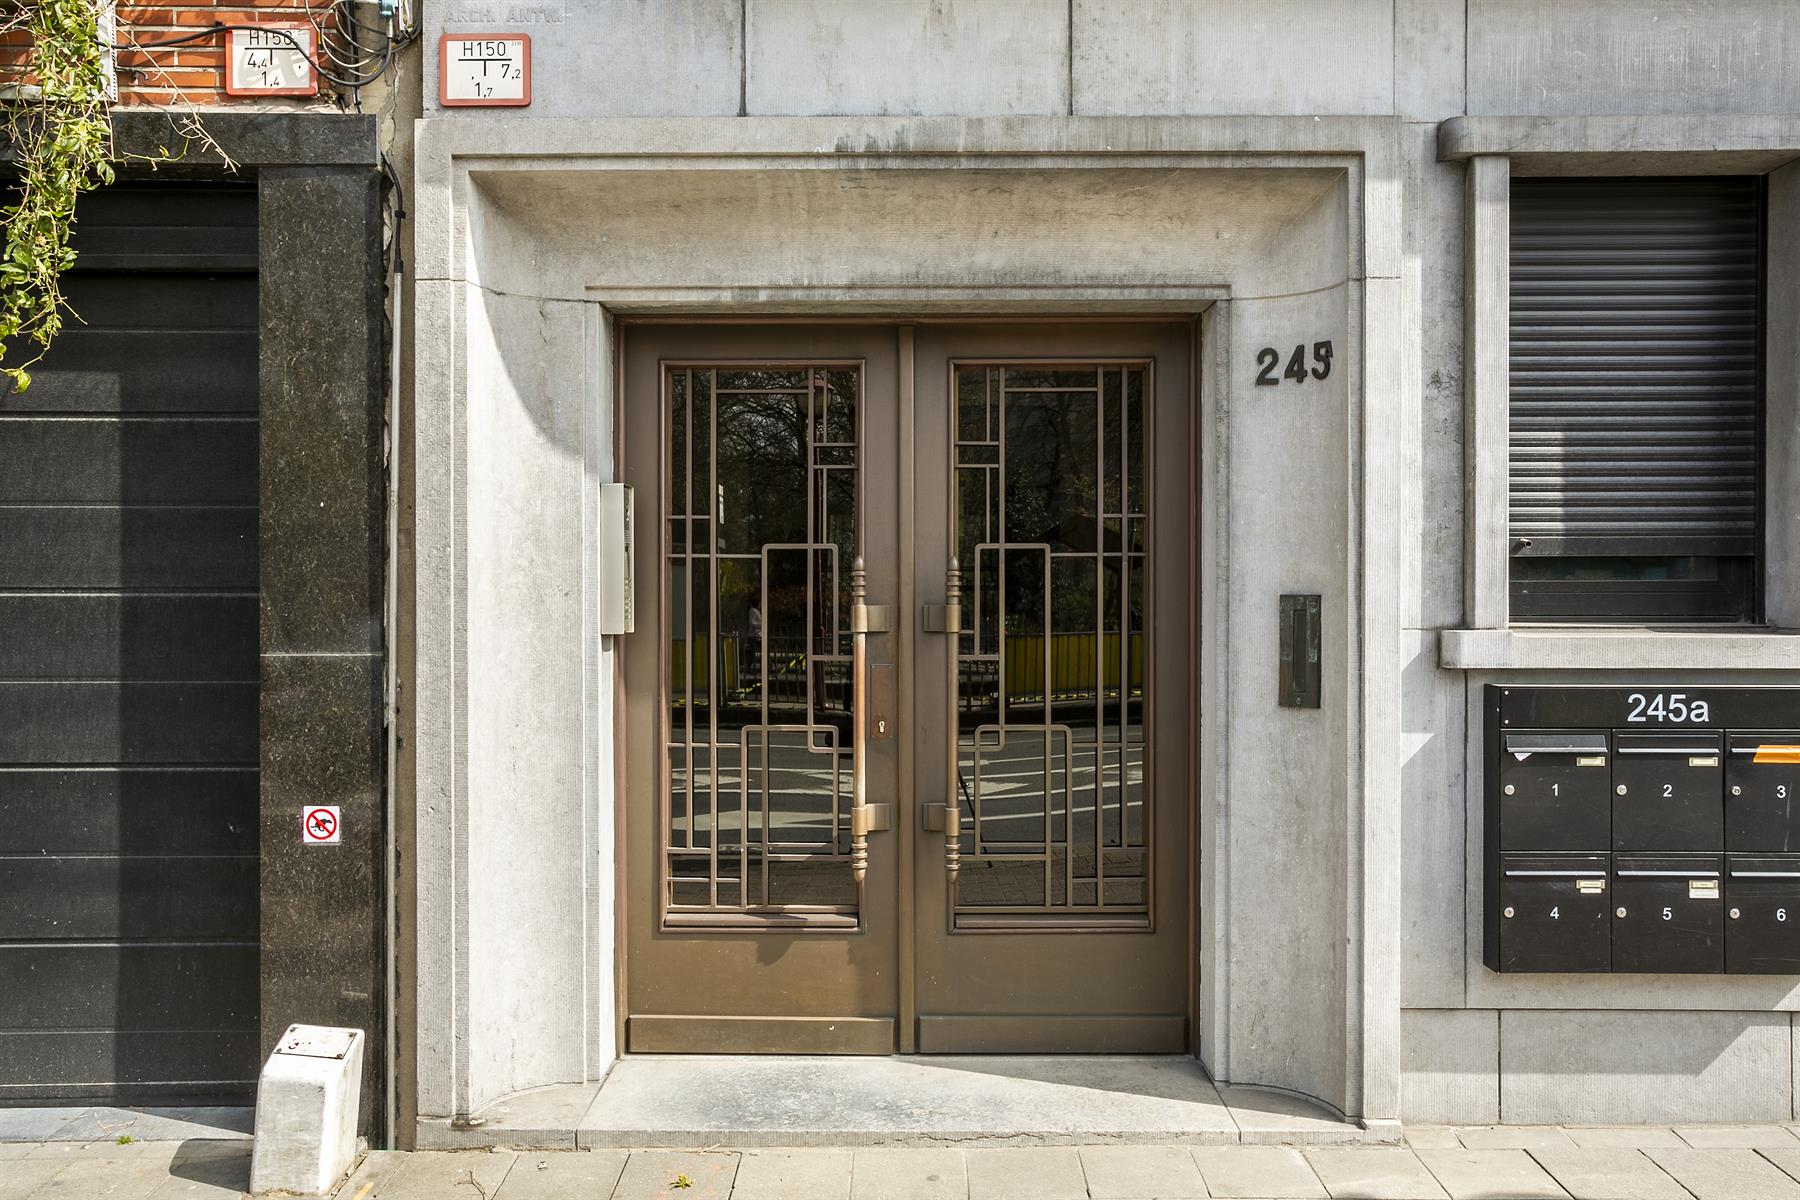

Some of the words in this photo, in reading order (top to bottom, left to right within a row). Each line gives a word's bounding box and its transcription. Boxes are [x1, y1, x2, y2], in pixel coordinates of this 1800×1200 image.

[463, 41, 506, 57] H150
[501, 63, 522, 80] 7,2
[474, 82, 493, 98] 1,7
[1255, 340, 1334, 387] 245
[1627, 693, 1710, 722] 245a
[1551, 783, 1560, 797] 1
[1662, 784, 1673, 798] 2
[1776, 785, 1787, 799] 3
[1549, 906, 1560, 920] 4
[1662, 907, 1672, 921] 5
[1776, 908, 1787, 922] 6
